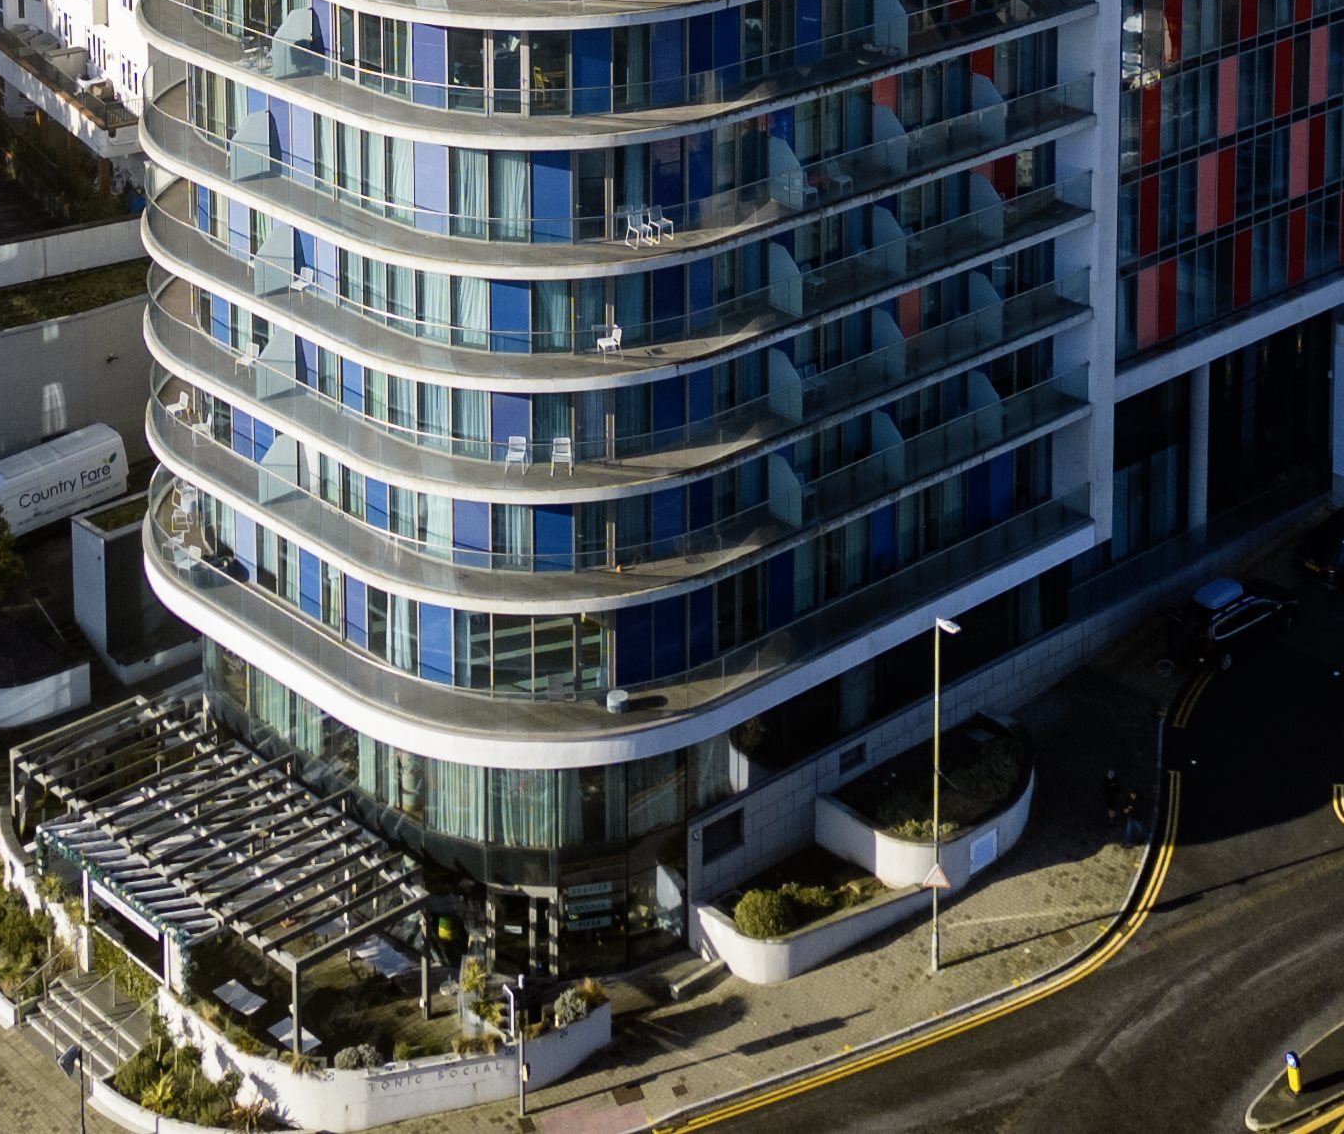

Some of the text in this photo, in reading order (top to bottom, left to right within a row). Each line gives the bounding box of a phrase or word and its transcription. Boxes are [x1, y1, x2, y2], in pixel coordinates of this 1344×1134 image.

[19, 476, 77, 509] Country
[80, 464, 111, 485] Fare
[368, 1064, 504, 1092] TONIC SOCIAL
